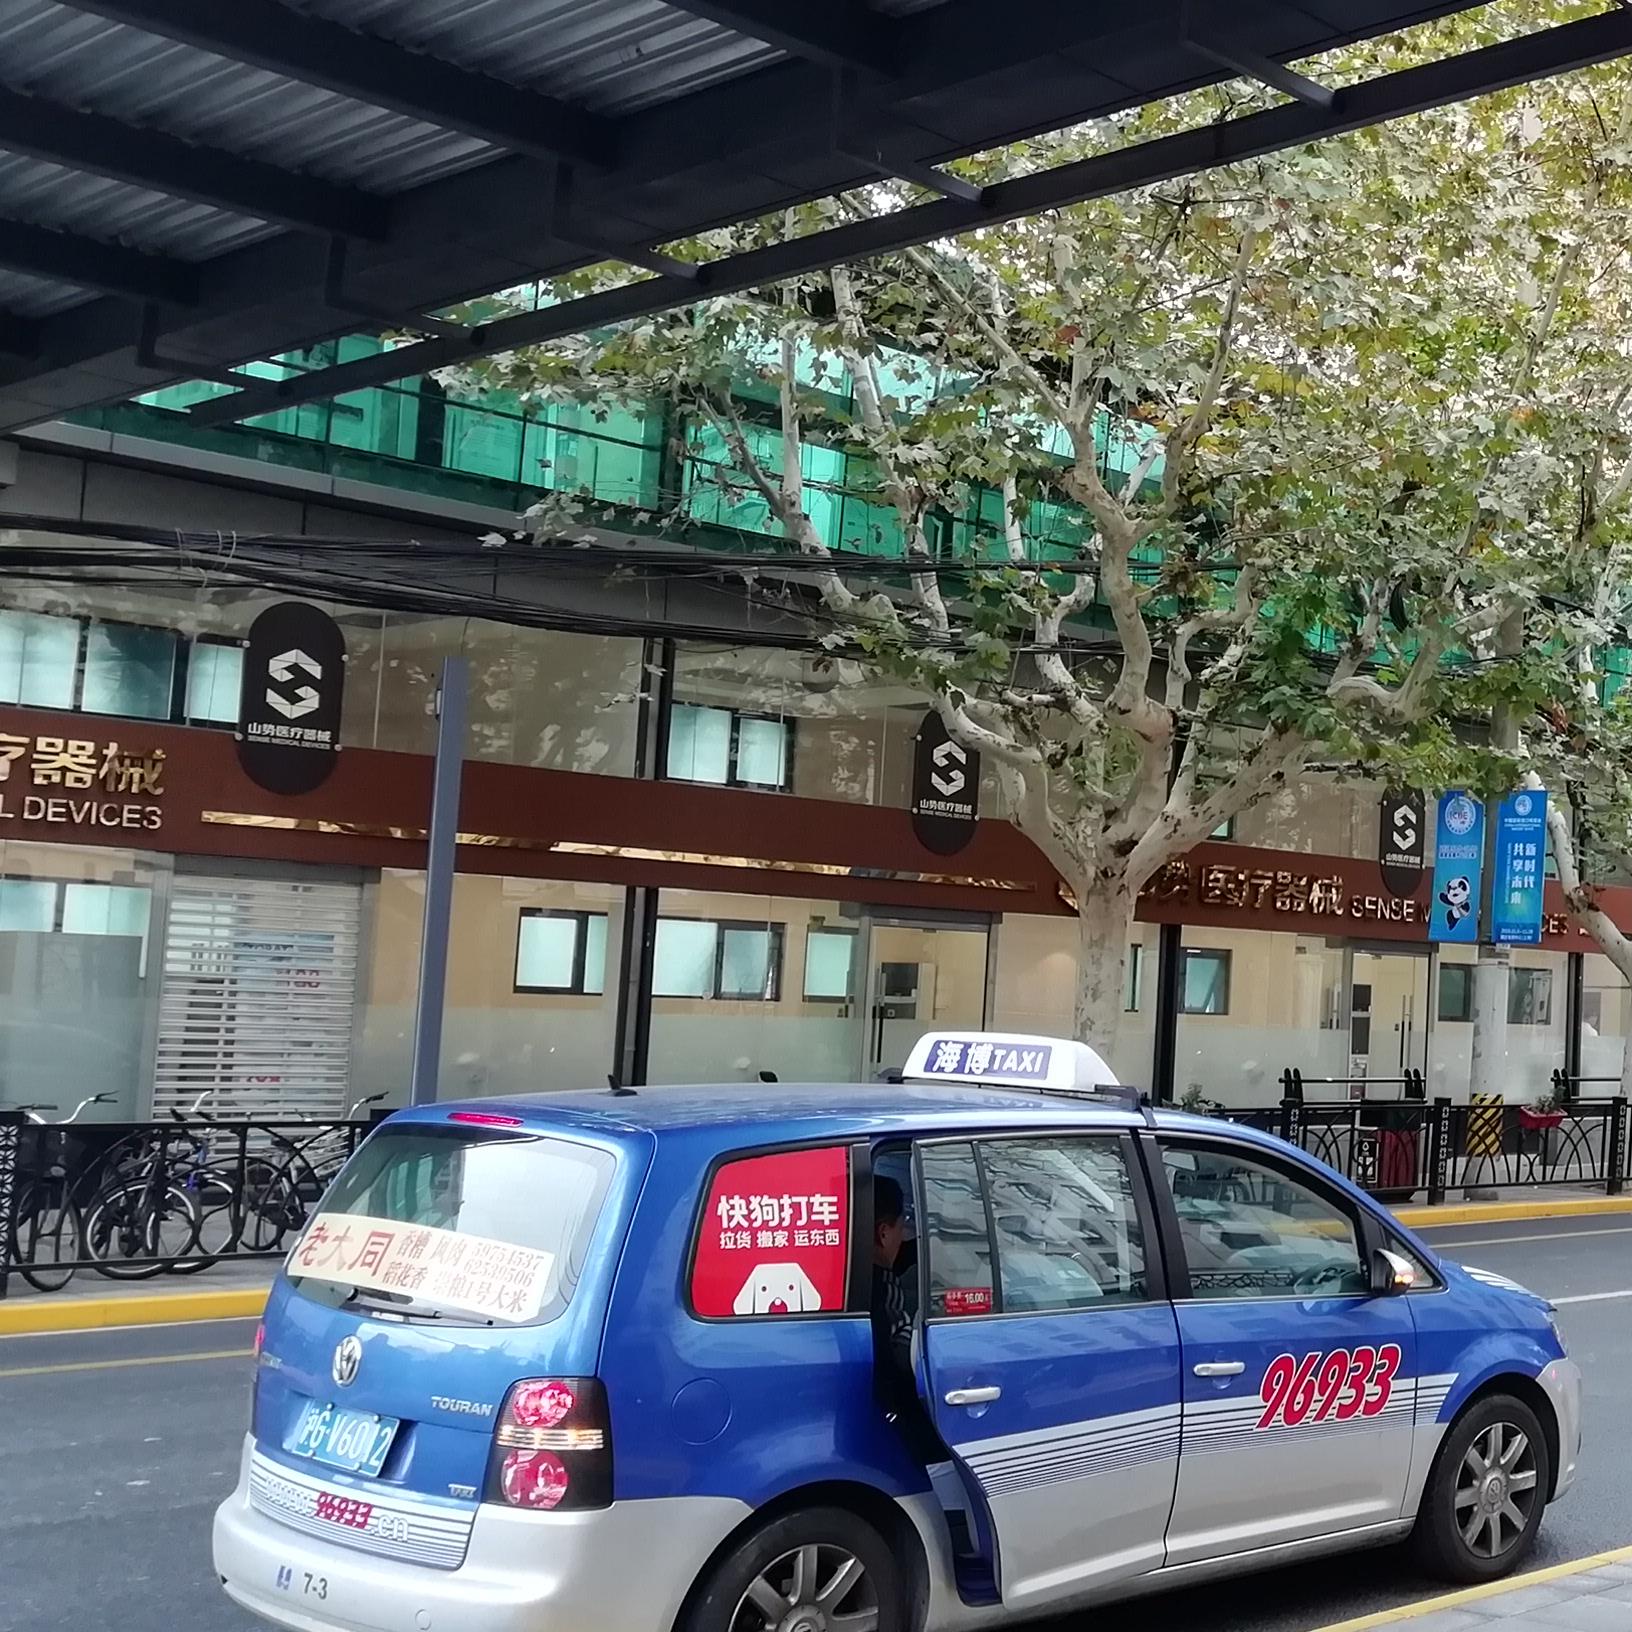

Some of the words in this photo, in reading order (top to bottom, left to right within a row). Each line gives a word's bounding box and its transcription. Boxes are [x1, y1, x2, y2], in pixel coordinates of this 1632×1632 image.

[23, 796, 163, 829] DEVICES
[1351, 894, 1414, 922] SENSE
[717, 1193, 840, 1229] 快狗打车
[299, 1222, 396, 1278] 老大同
[719, 1231, 752, 1250] 拉货
[756, 1230, 789, 1249] 搬家
[793, 1229, 840, 1247] 运东西
[1253, 1343, 1402, 1431] 96933
[431, 1396, 493, 1416] TOURAN
[303, 1571, 329, 1600] 7-3
